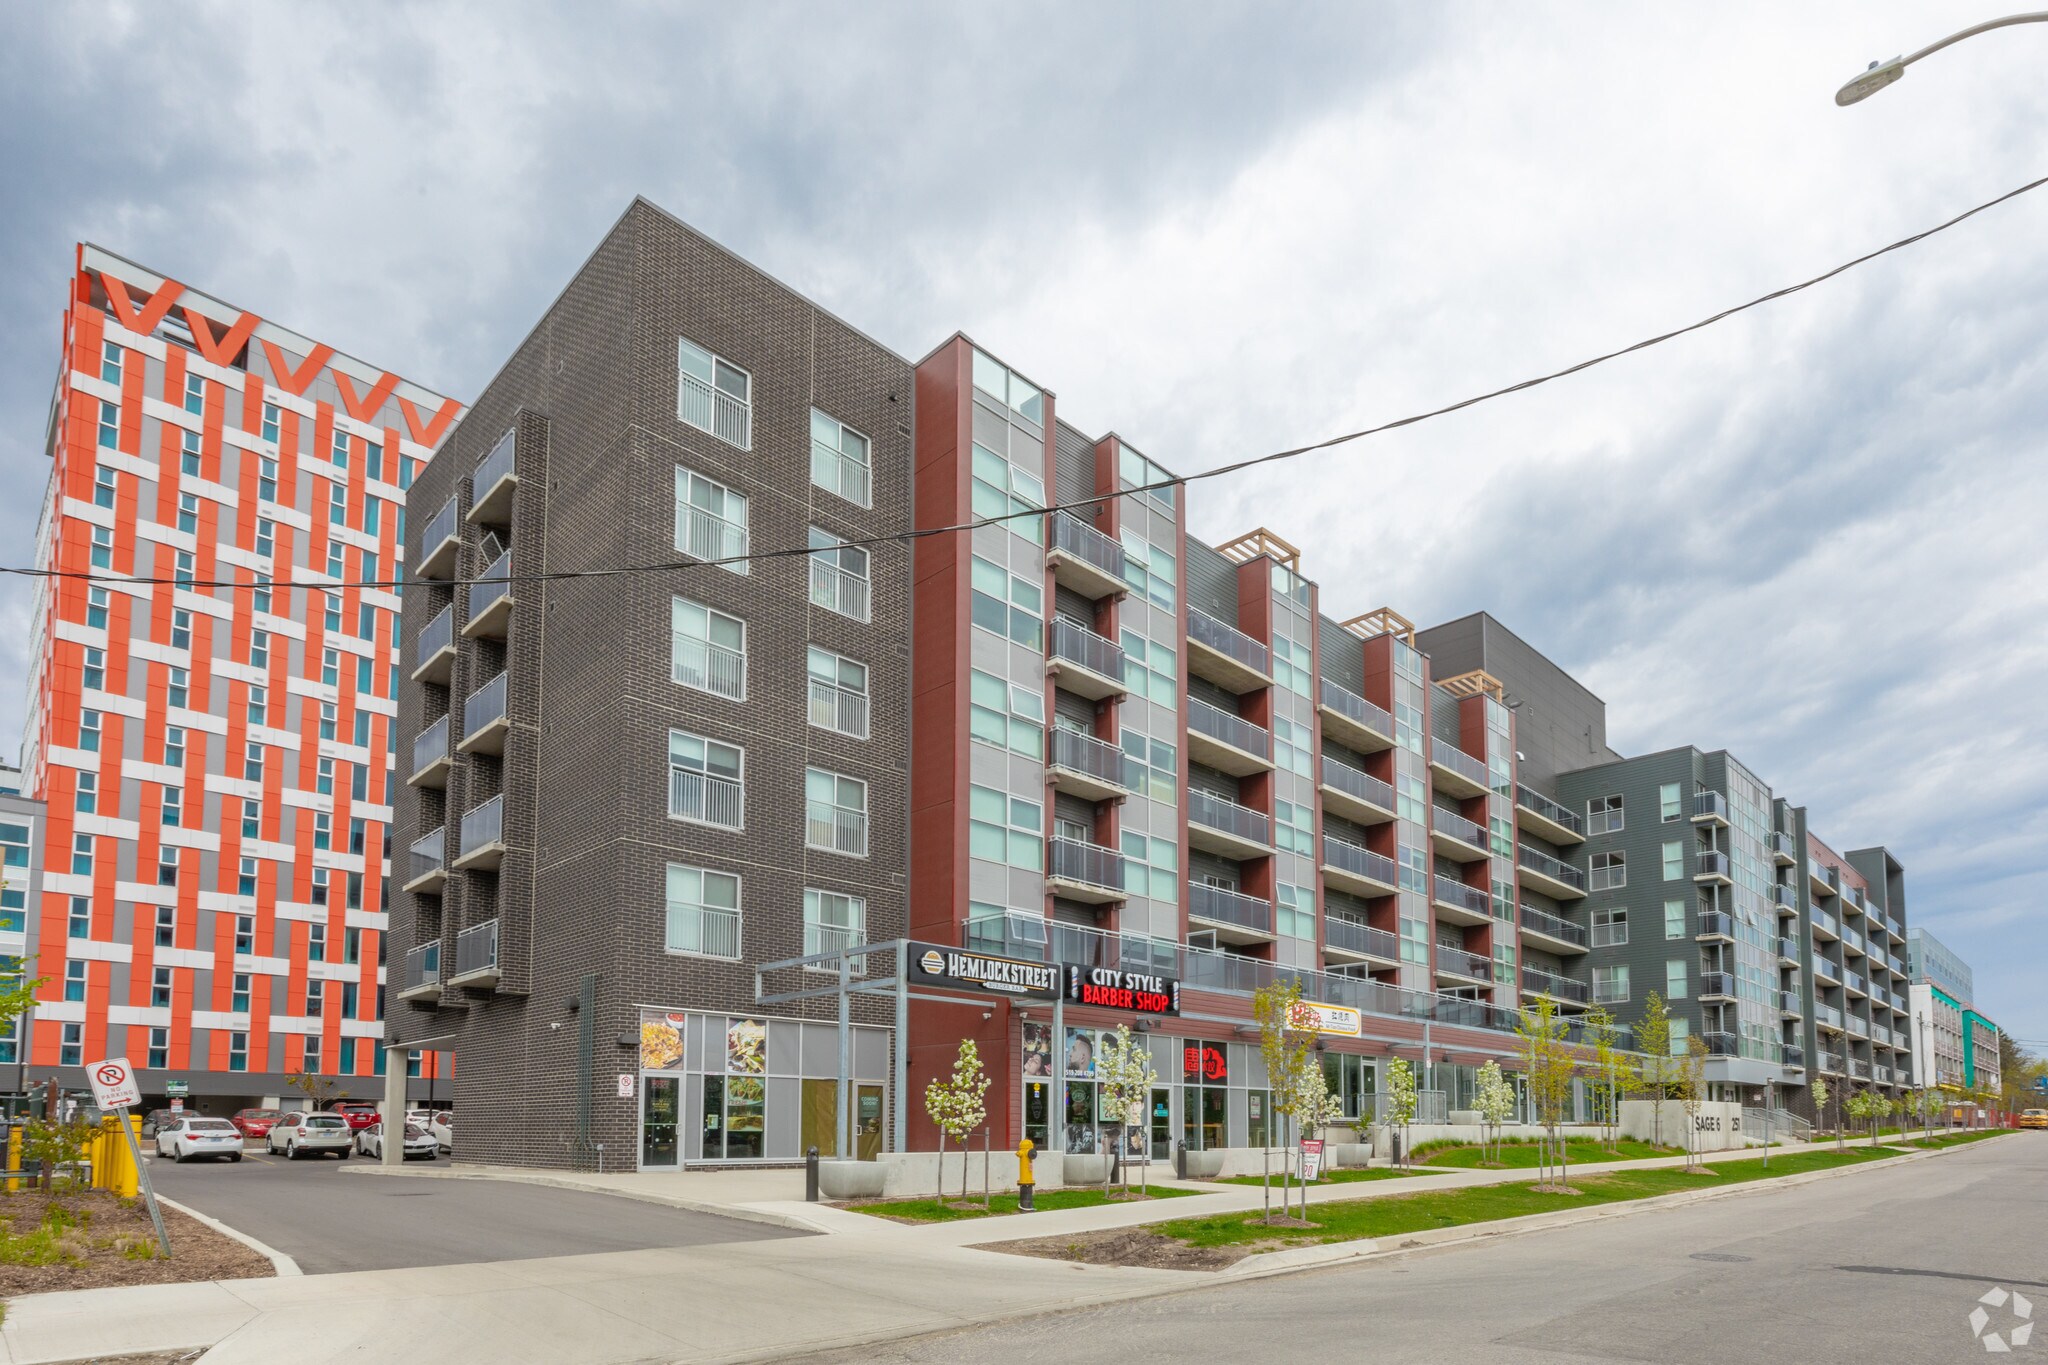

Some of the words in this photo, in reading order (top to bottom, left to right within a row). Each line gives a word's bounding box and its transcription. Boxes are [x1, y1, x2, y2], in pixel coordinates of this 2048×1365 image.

[988, 982, 1010, 990] BURGER
[1092, 968, 1122, 988] CITY
[1125, 973, 1162, 993] STYLE
[1083, 984, 1133, 1008] BARBER
[1136, 991, 1169, 1012] SHOP
[101, 1090, 134, 1100] PARKING
[1695, 1116, 1715, 1131] SAGE
[1716, 1118, 1720, 1132] 6
